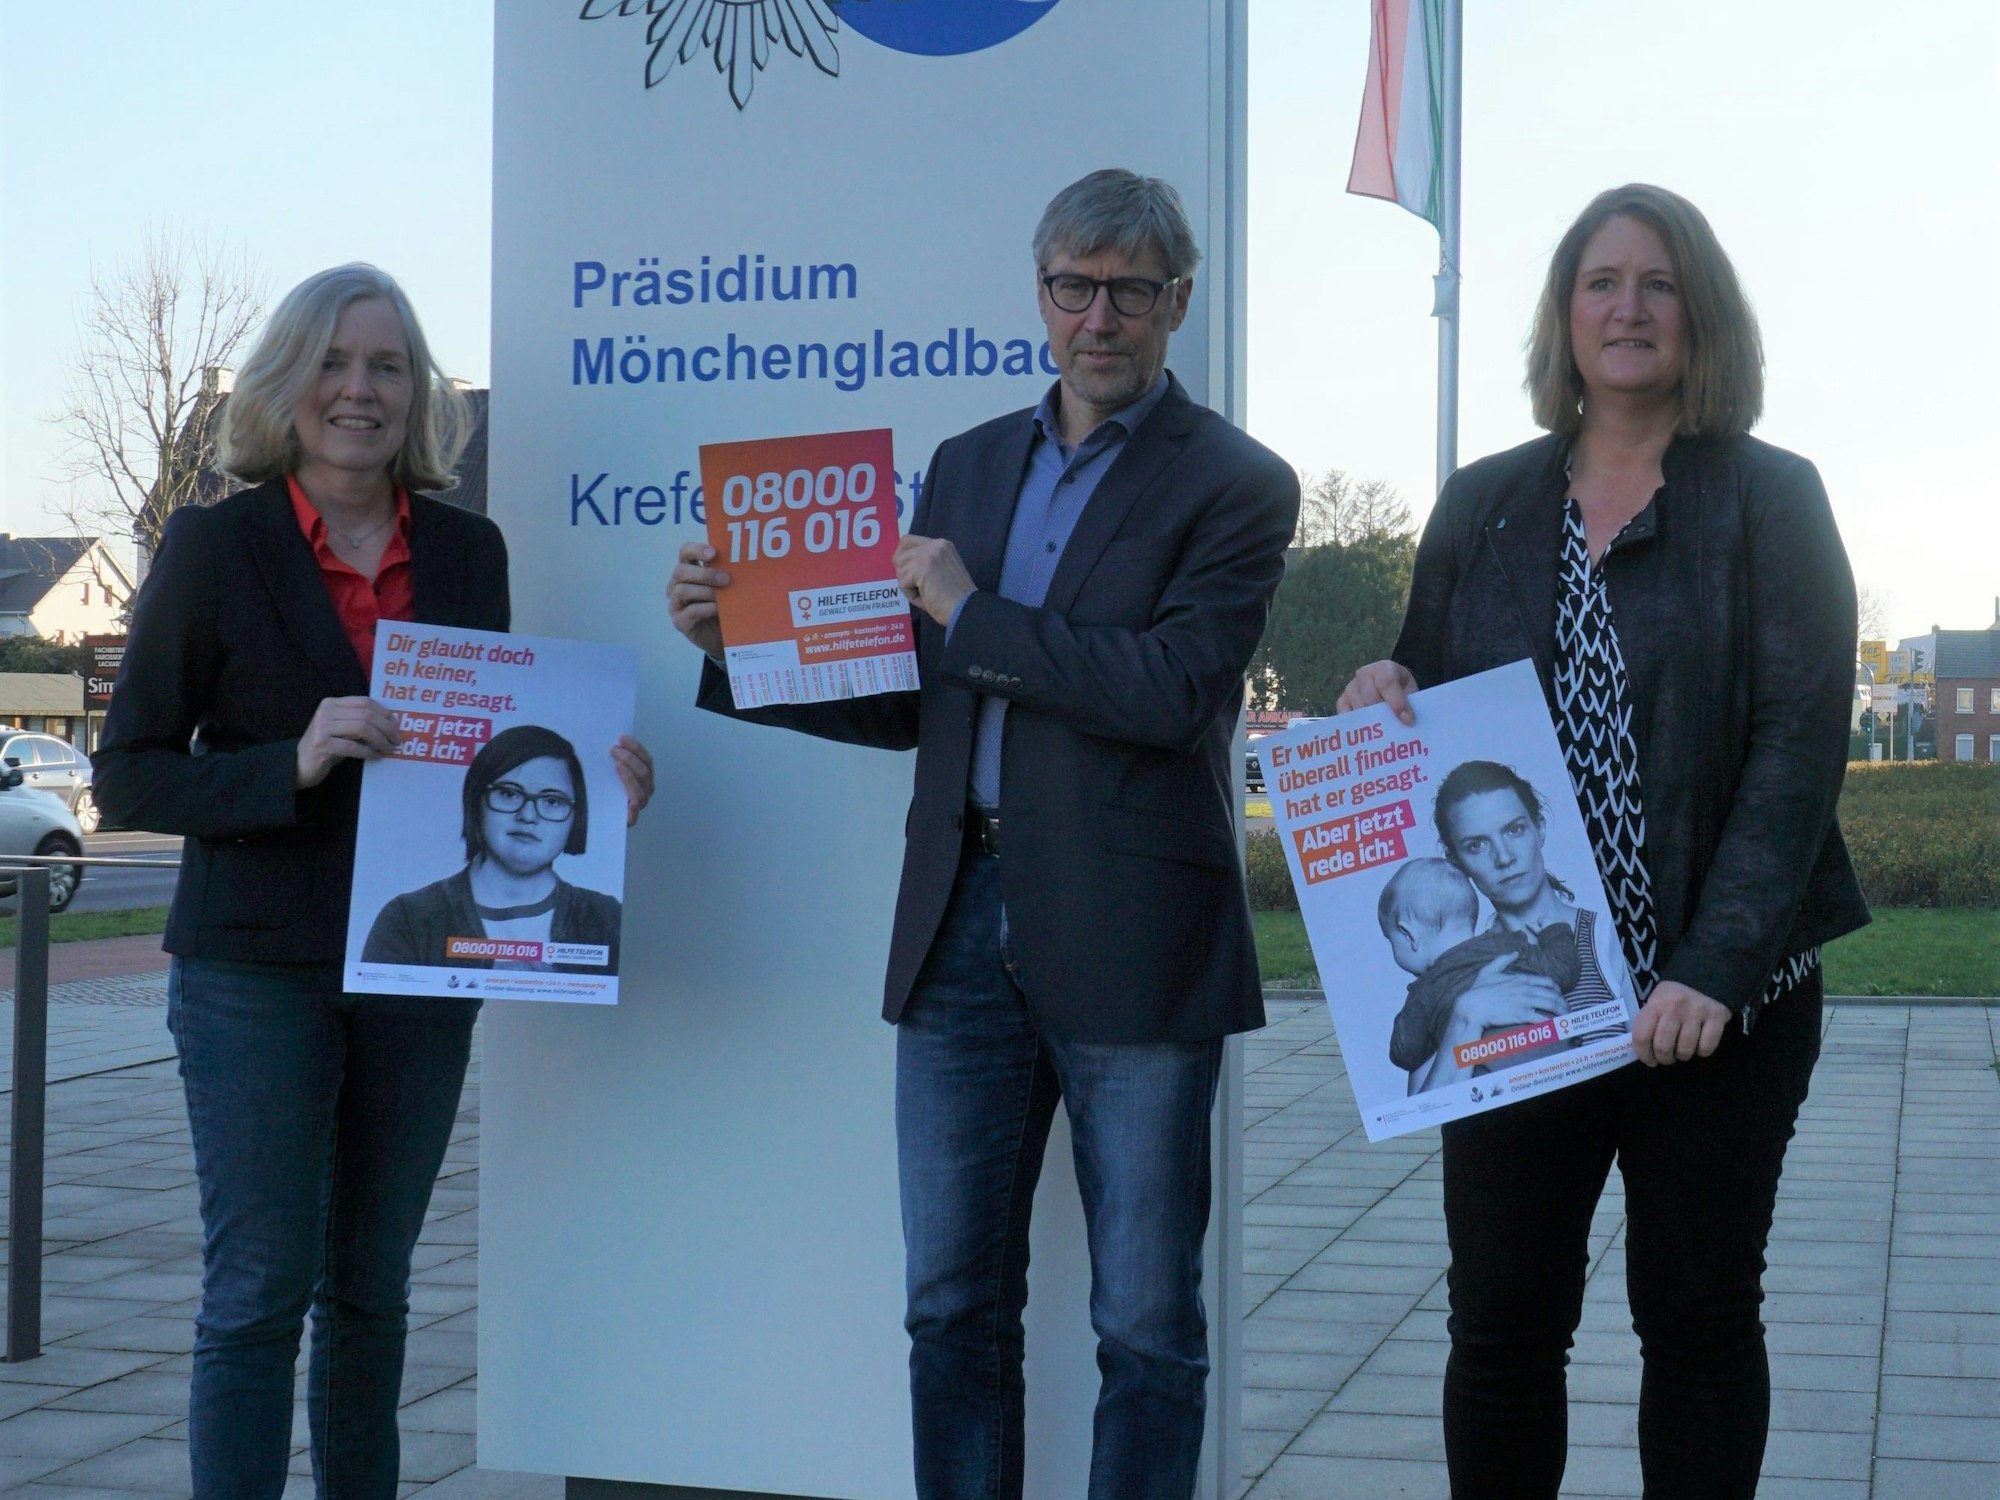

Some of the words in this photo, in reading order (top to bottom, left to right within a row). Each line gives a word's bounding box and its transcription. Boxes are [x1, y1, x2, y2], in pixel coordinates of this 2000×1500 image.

[573, 254, 858, 308] Präsidium
[722, 463, 876, 517] 08000
[727, 516, 791, 563] 116
[804, 506, 880, 553] 016
[819, 606, 847, 617] GEWALT
[847, 603, 872, 613] GEGEN
[872, 600, 900, 610] FRAUEN
[387, 634, 416, 653] Dir
[418, 638, 484, 661] glaubt
[487, 645, 535, 666] doch
[805, 632, 906, 654] www.hilfetelefon.de
[385, 659, 409, 677] eh
[412, 660, 478, 686] keiner,
[382, 681, 416, 701] hat
[421, 688, 441, 703] er
[443, 692, 518, 713] gesagt.
[434, 716, 485, 738] jetzt
[1271, 746, 1293, 767] Er
[1297, 729, 1342, 761] wird
[1346, 722, 1384, 746] uns
[430, 740, 468, 761] ich:
[1279, 756, 1351, 793] überall
[1354, 739, 1429, 777] finden,
[1285, 792, 1322, 820] hat
[1325, 788, 1346, 809] er
[1350, 764, 1429, 806] gesagt.
[1302, 823, 1351, 853] Aber
[1354, 806, 1405, 842] jetzt
[1308, 850, 1355, 879] rede
[1358, 837, 1396, 865] ich:
[452, 940, 497, 954] 08000
[497, 943, 515, 955] 116
[516, 944, 539, 958] 016
[1460, 1038, 1507, 1063] 08000
[1507, 1030, 1527, 1049] 116
[1528, 1024, 1552, 1044] 016
